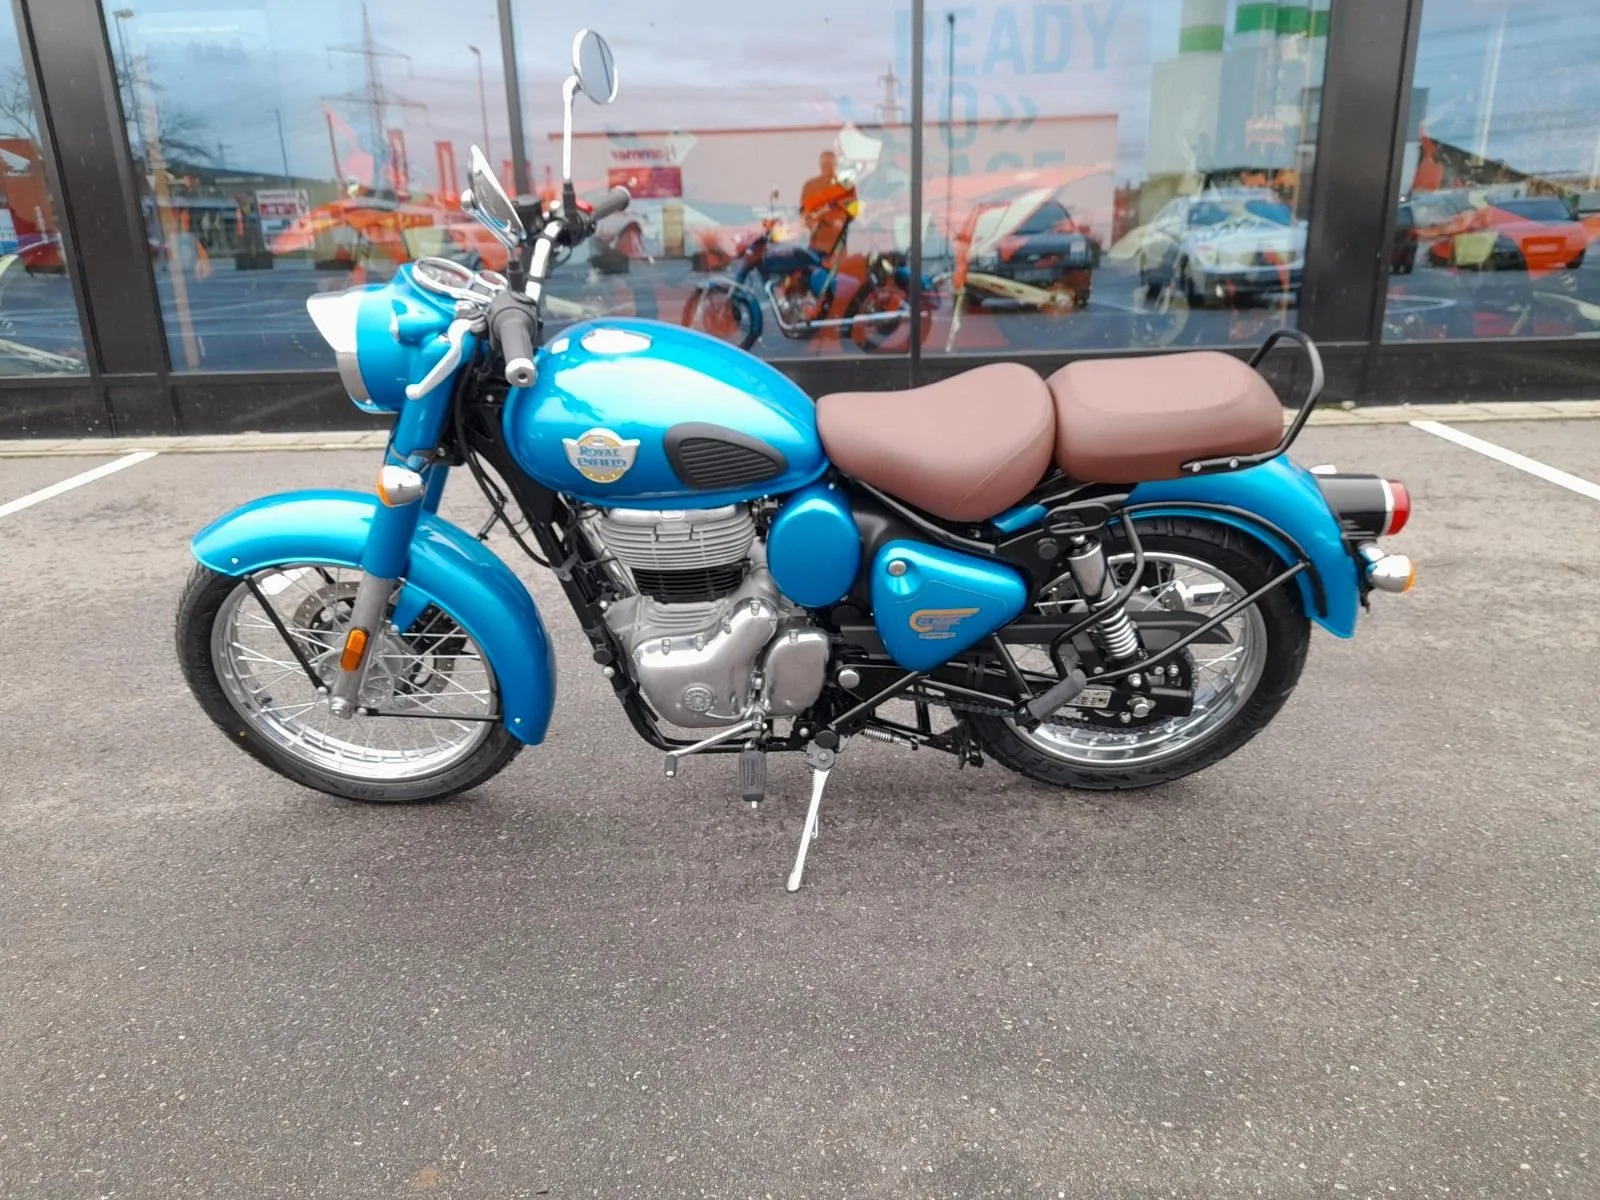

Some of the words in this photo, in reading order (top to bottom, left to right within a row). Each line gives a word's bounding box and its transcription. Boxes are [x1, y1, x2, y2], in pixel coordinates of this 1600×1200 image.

[894, 2, 1123, 77] READY
[580, 446, 620, 457] ROYAL
[578, 457, 626, 467] ENFIELD
